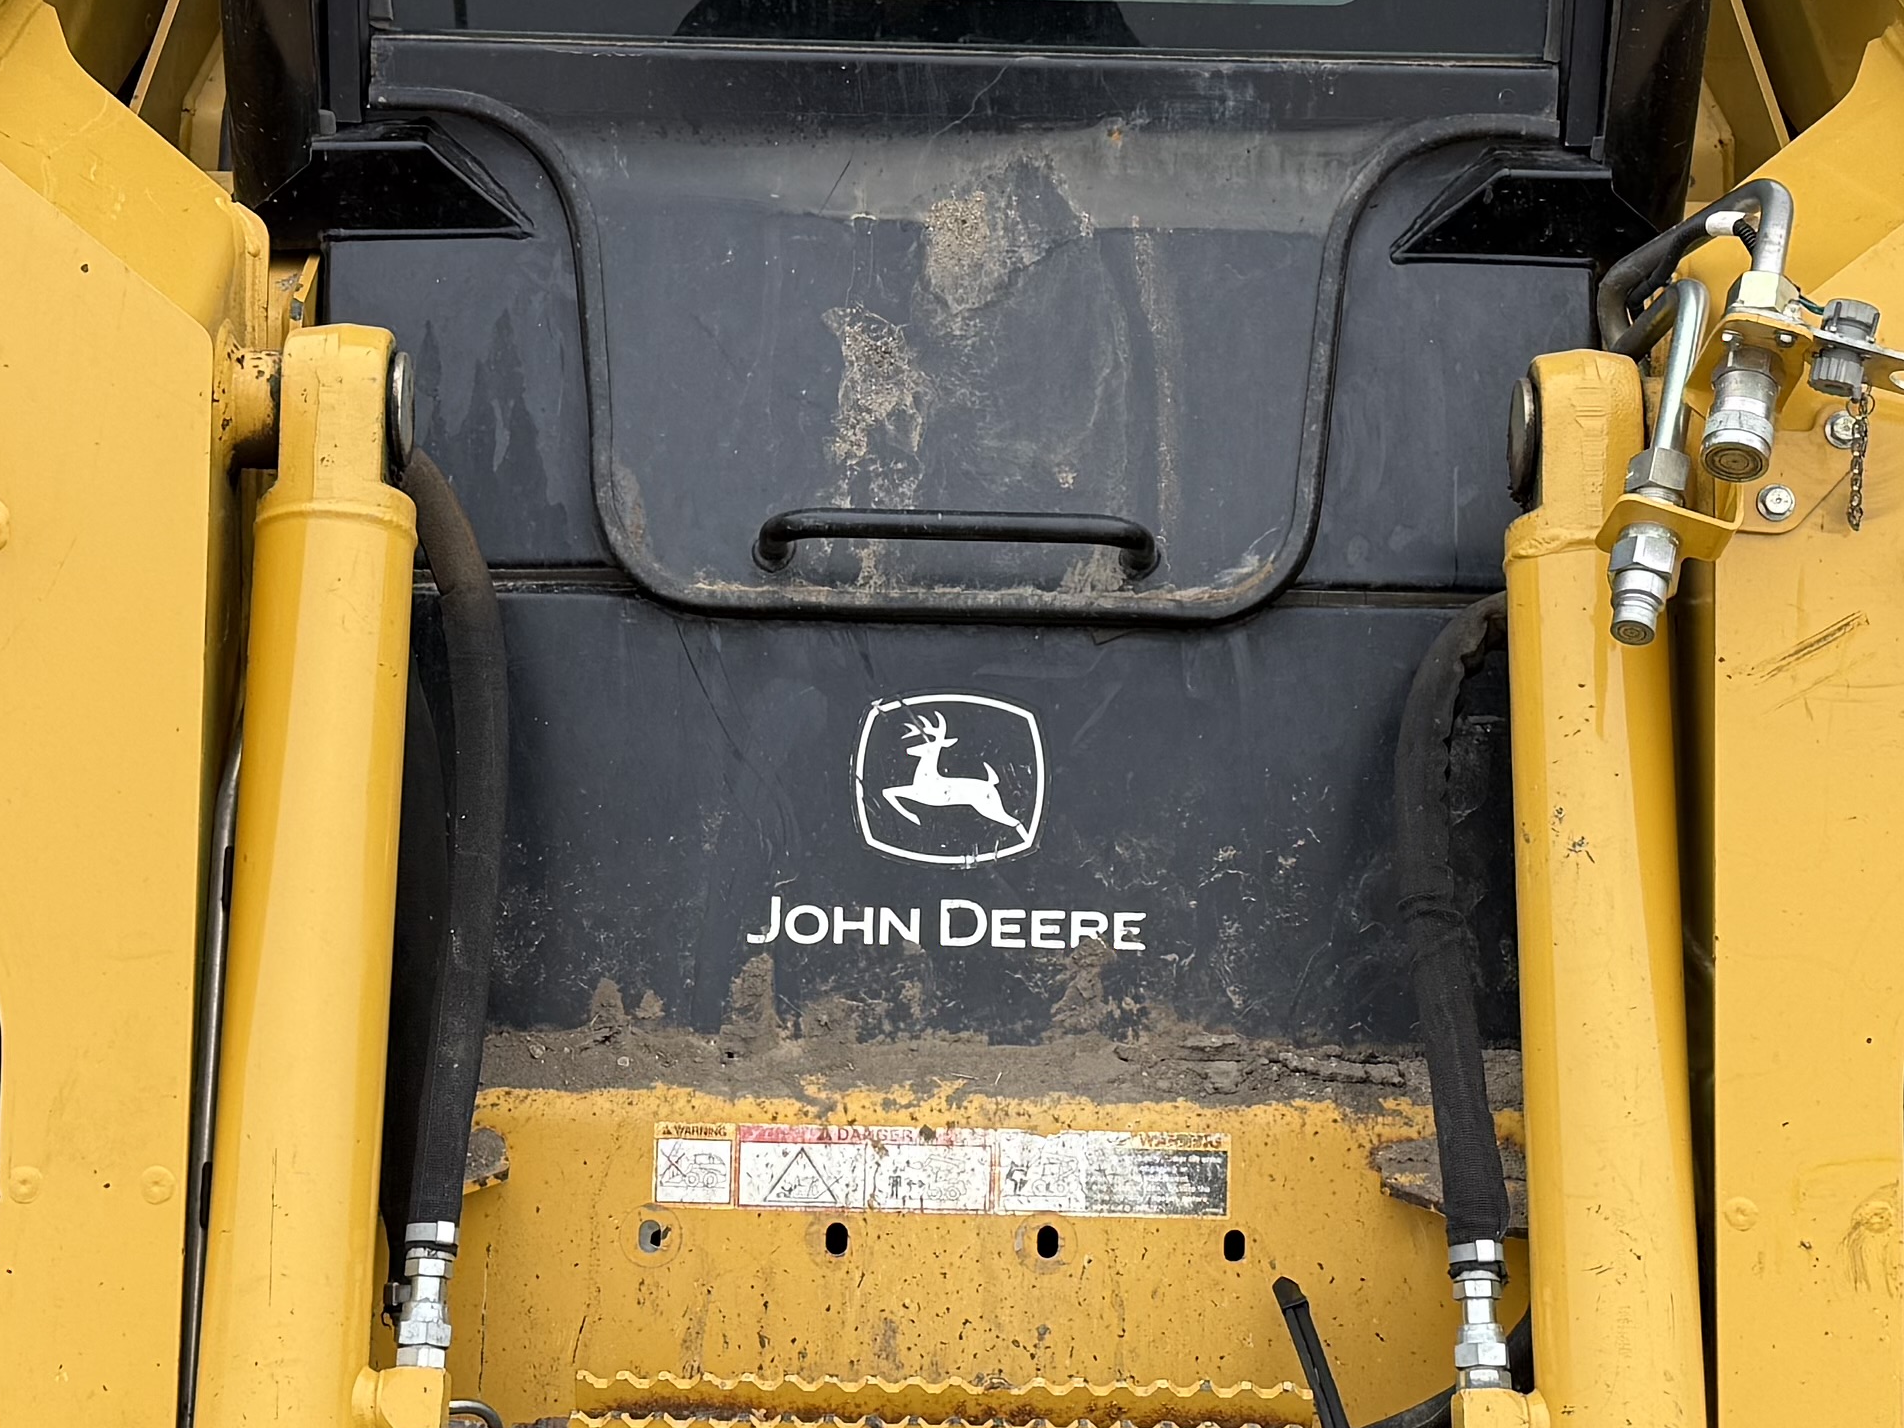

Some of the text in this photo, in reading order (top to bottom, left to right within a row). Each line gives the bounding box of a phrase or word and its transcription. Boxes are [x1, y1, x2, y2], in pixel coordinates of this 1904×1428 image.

[746, 895, 1147, 951] JOHN DEERE
[674, 1124, 728, 1137] WARNING
[837, 1127, 914, 1142] DANGER
